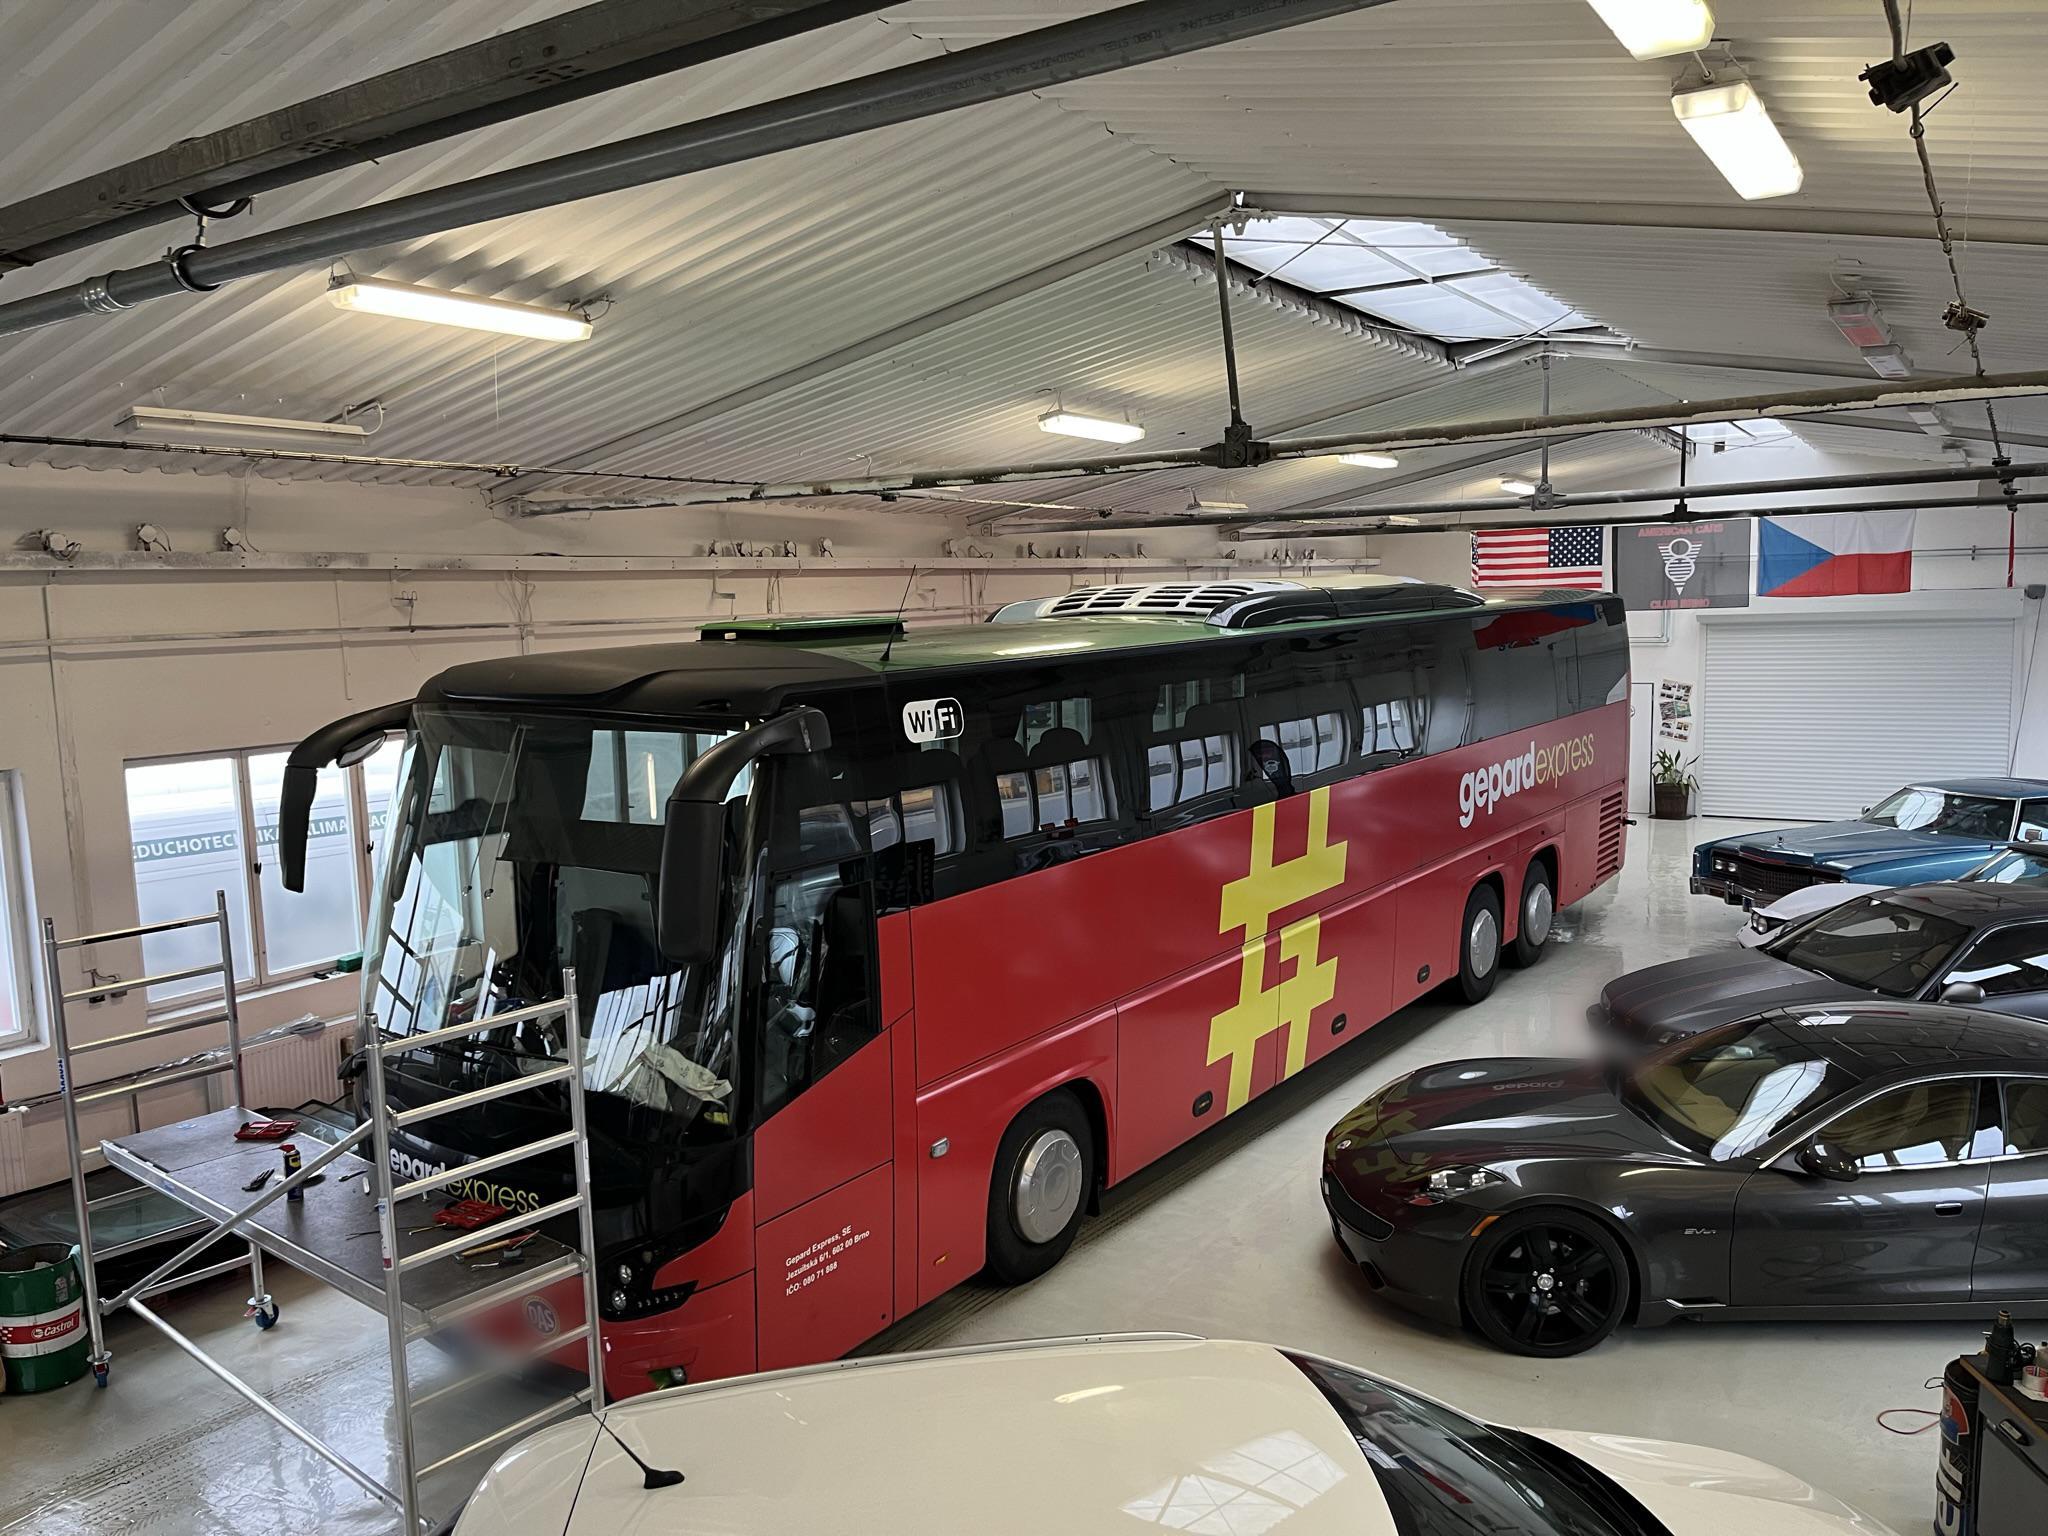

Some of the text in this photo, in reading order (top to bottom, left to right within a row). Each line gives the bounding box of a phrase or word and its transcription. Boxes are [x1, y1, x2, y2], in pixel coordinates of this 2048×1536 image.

[907, 706, 956, 733] WiFi
[786, 1225, 852, 1267] Gepard Express, SE
[844, 1238, 853, 1249] 00
[854, 1230, 870, 1243] Brno
[816, 1268, 825, 1280] 71
[44, 1317, 74, 1337] Castrol
